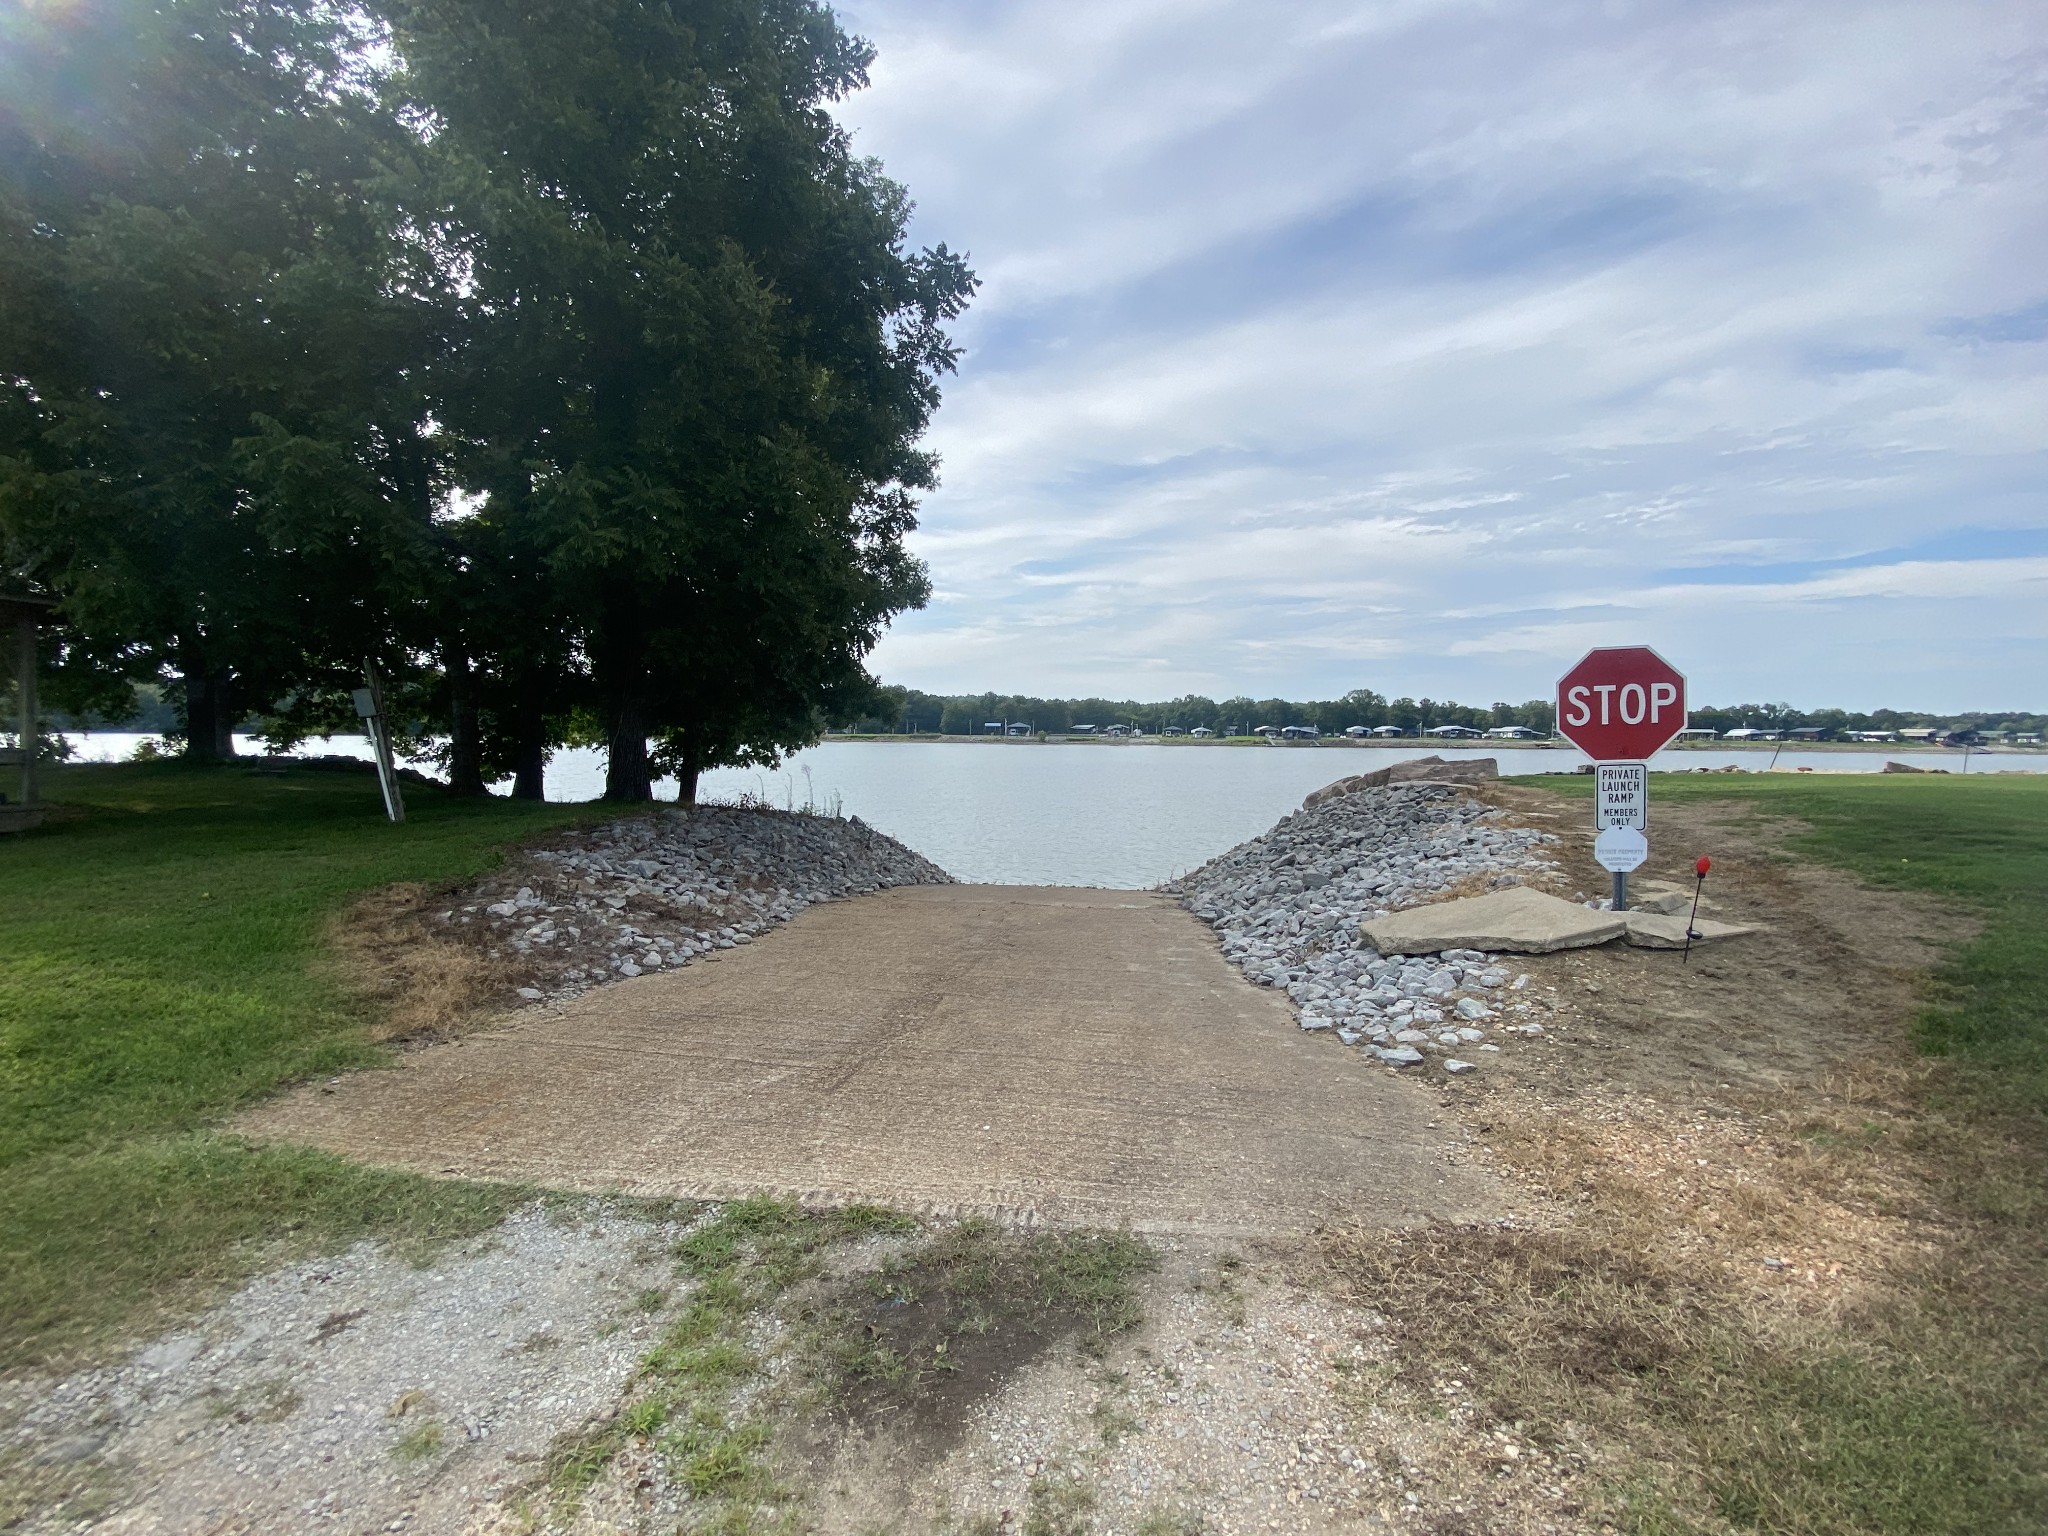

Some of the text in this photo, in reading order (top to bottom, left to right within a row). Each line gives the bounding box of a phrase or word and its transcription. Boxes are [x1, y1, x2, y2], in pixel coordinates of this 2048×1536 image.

[1566, 682, 1677, 727] STOP
[1602, 769, 1640, 780] PRIVATE
[1602, 781, 1640, 792] LAUNCH
[1608, 792, 1634, 803] RAMP
[1603, 808, 1638, 817] MEMBERS
[1610, 817, 1630, 826] ONLY
